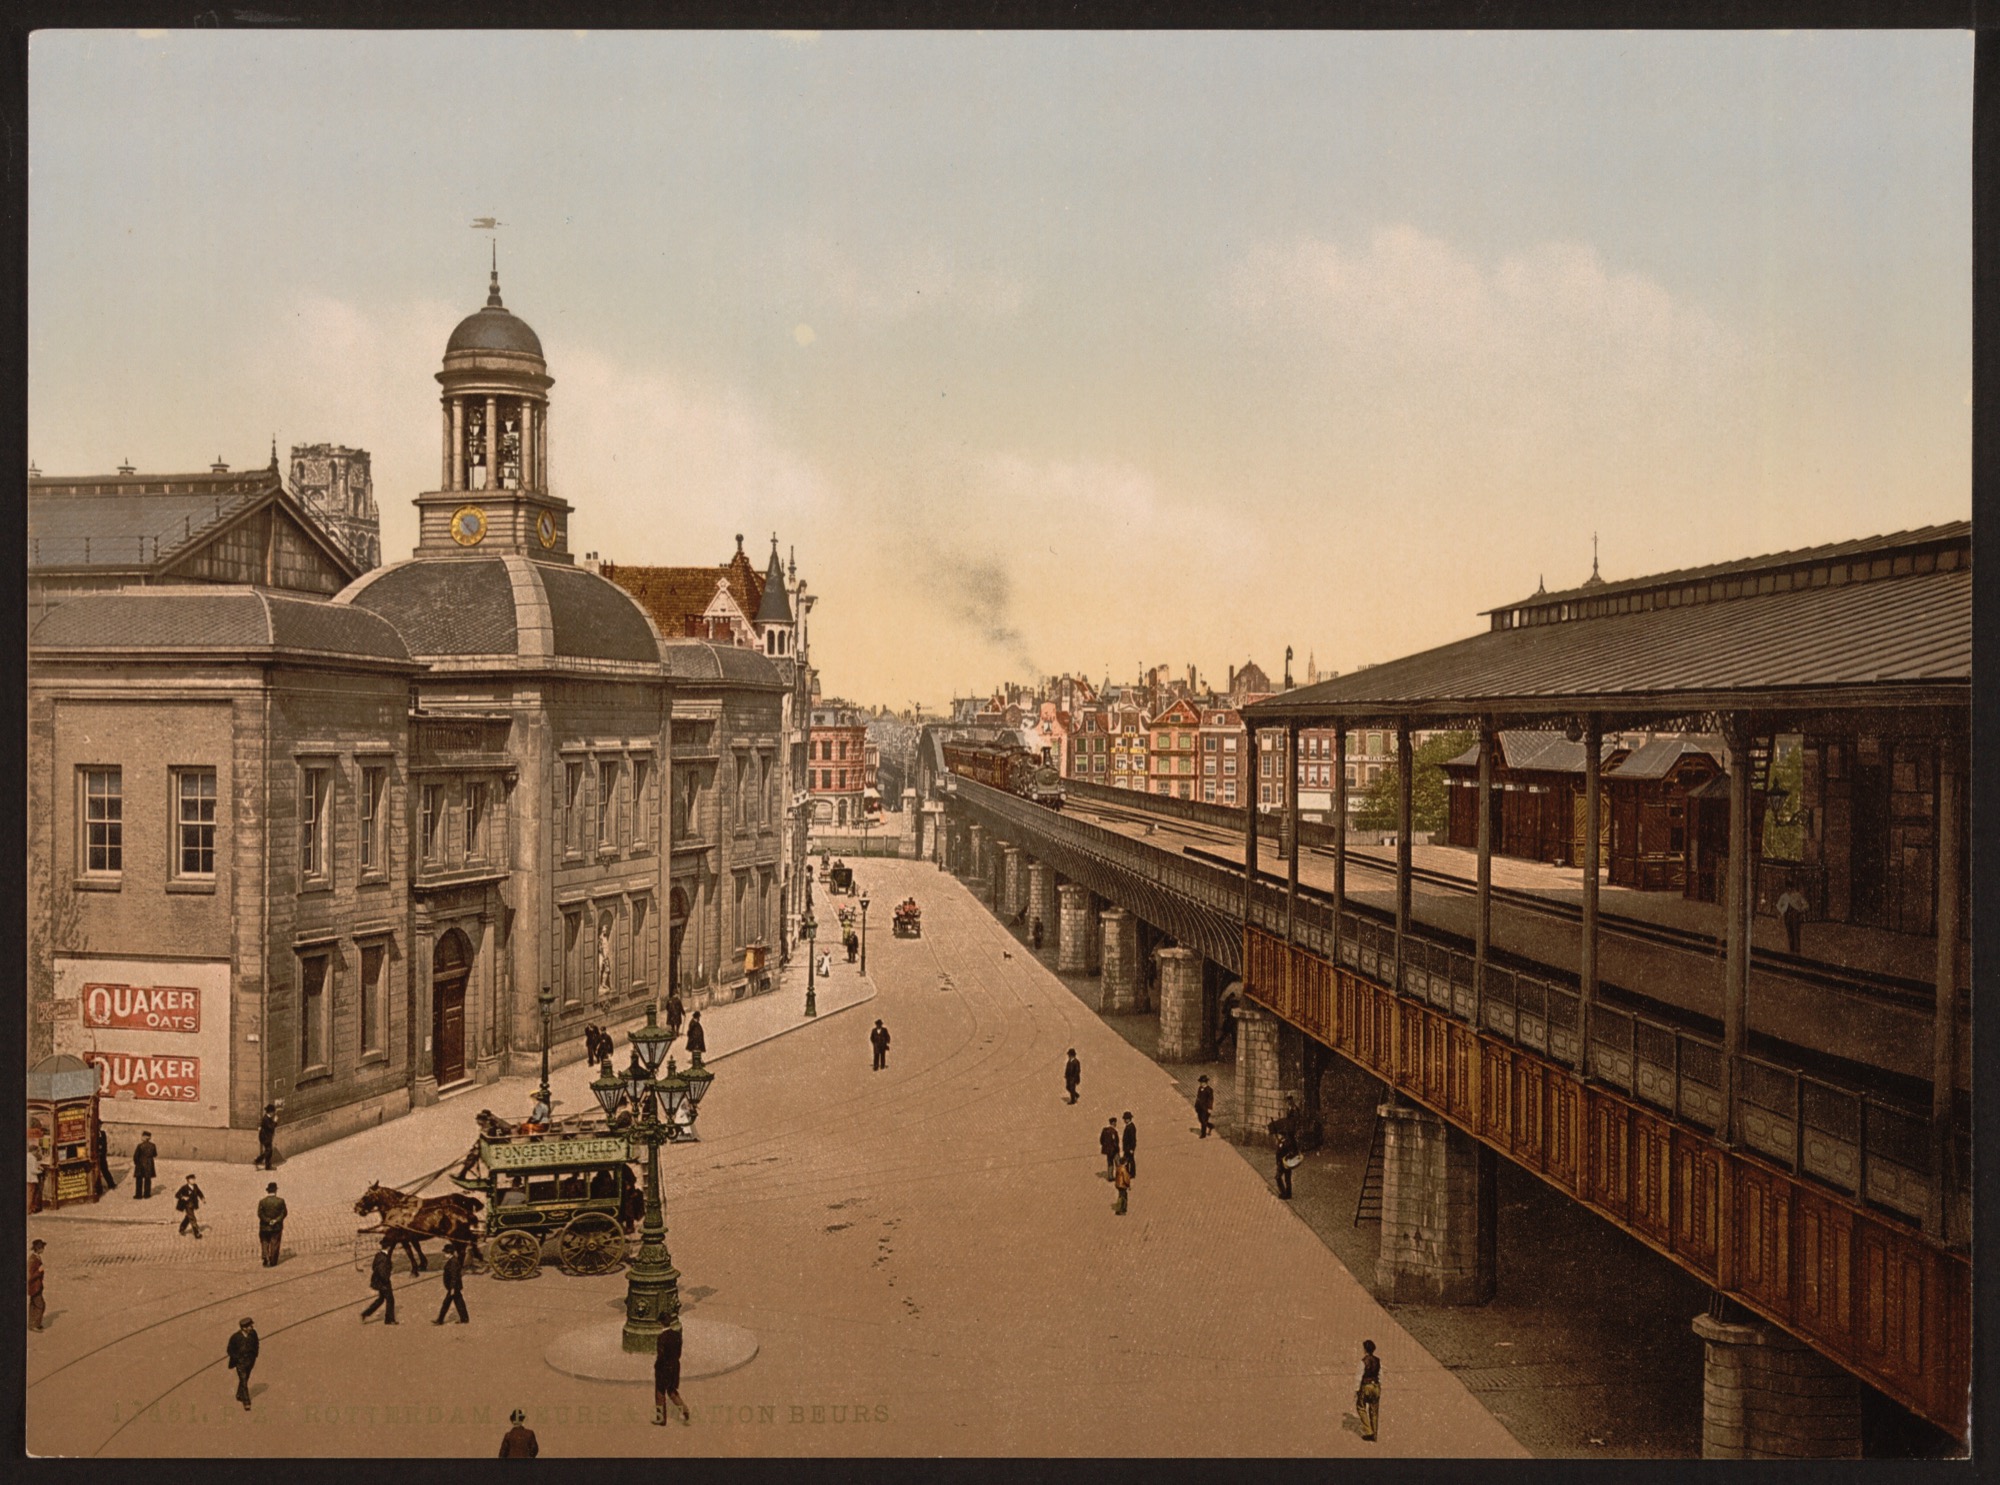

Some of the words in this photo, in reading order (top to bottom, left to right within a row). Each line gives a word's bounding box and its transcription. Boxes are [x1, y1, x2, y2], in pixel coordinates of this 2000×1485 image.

[88, 987, 195, 1025] QUAKER
[146, 1013, 196, 1029] OATS
[94, 1057, 195, 1094] QUAKER
[145, 1081, 196, 1098] OATS
[494, 1143, 556, 1159] FONGERS
